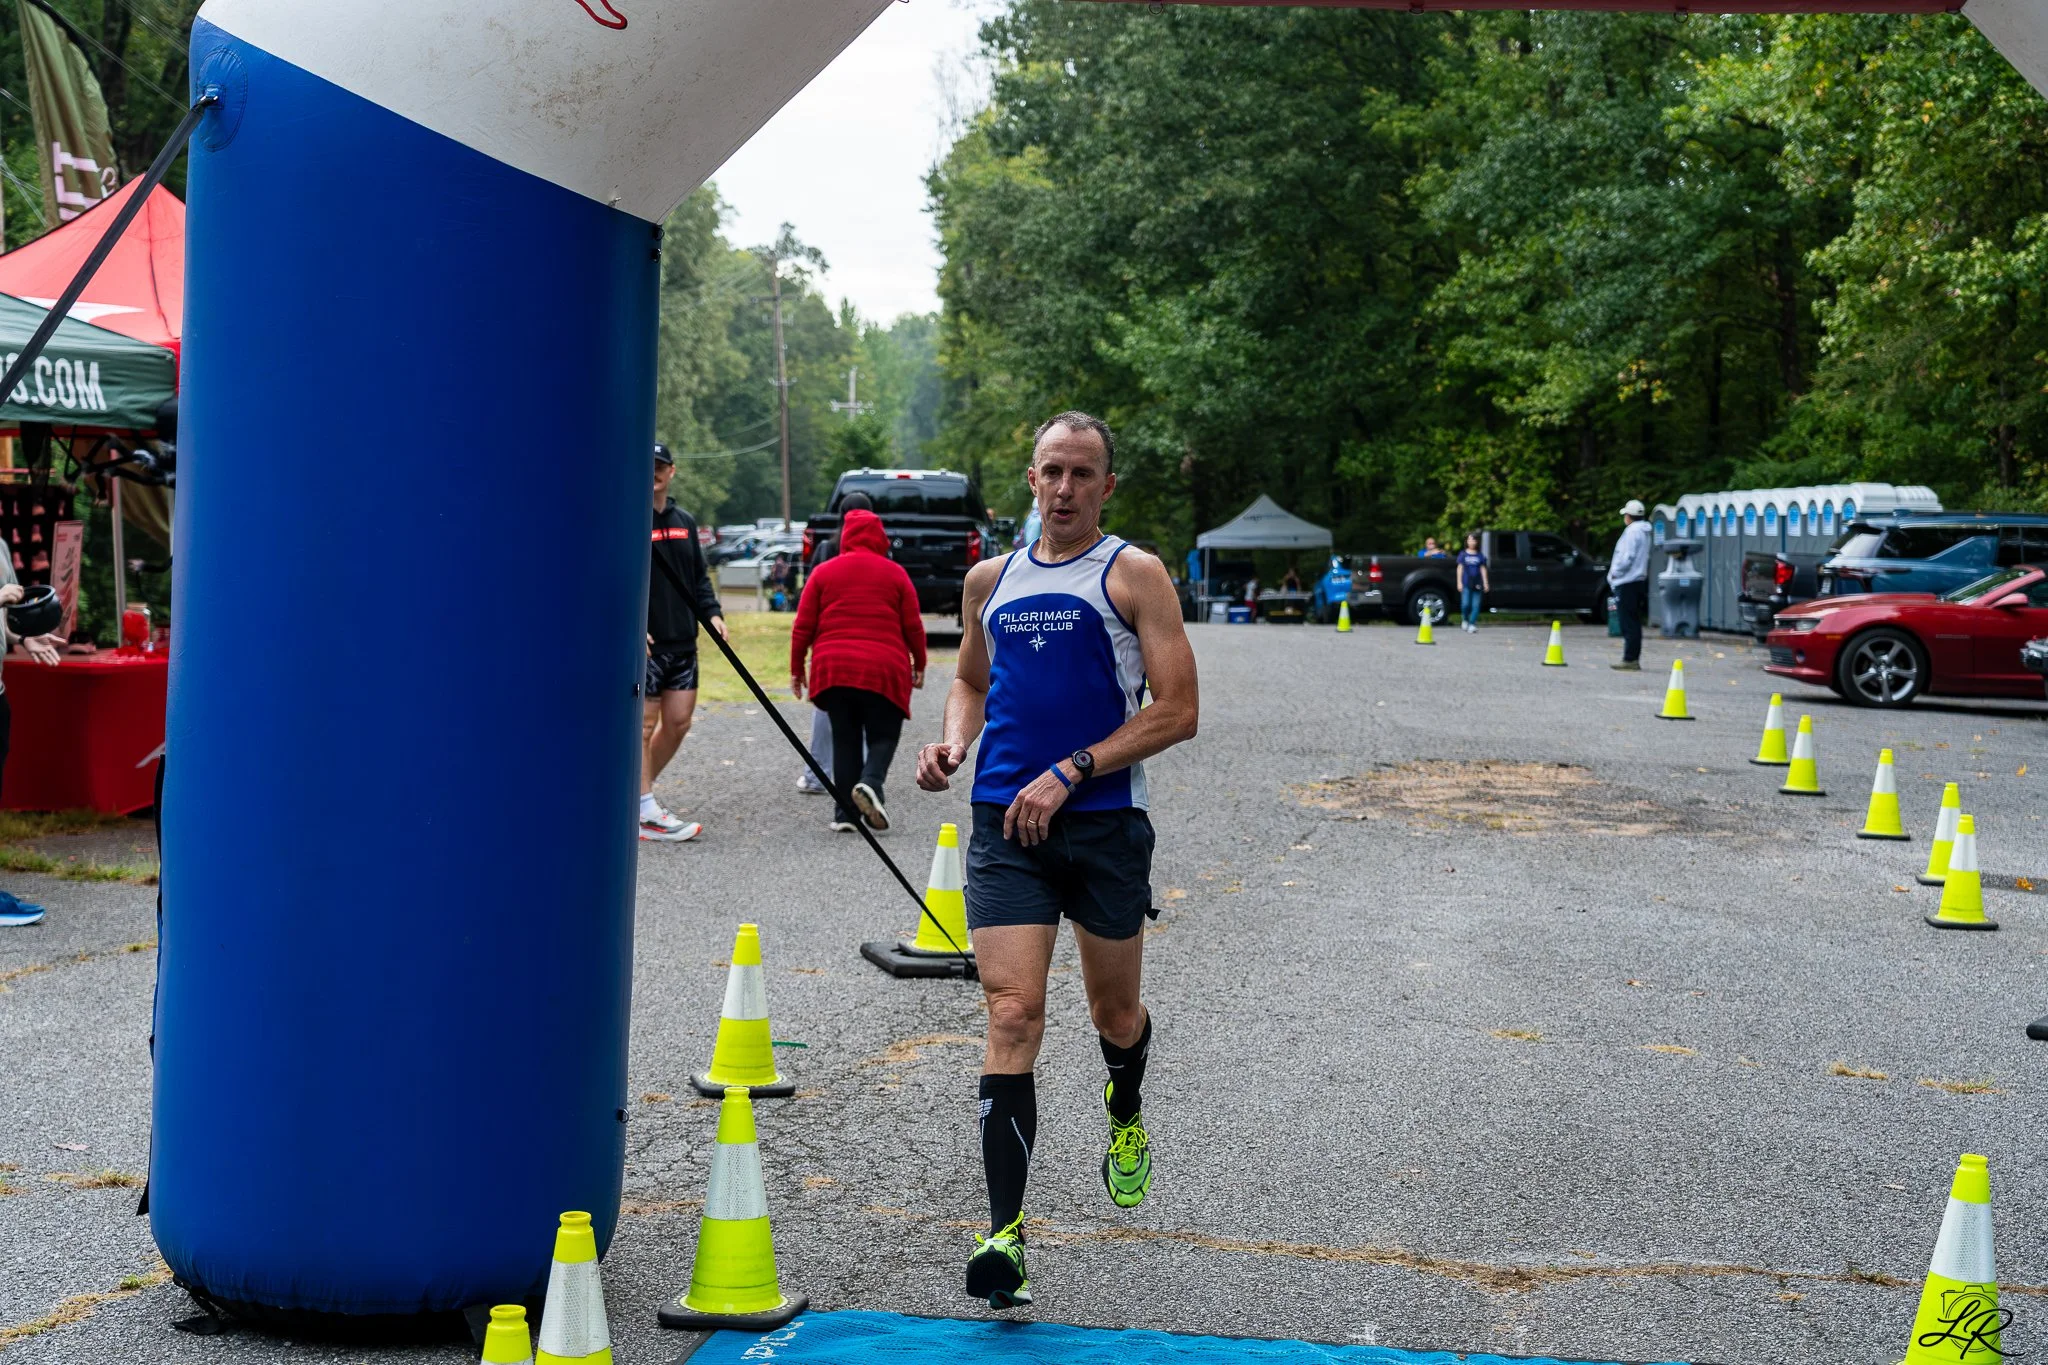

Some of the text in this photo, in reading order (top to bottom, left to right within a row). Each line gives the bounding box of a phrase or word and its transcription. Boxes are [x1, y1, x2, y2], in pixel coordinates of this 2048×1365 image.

[998, 610, 1081, 625] PILGRIMAGE
[1004, 621, 1074, 634] TRACK CLUB
